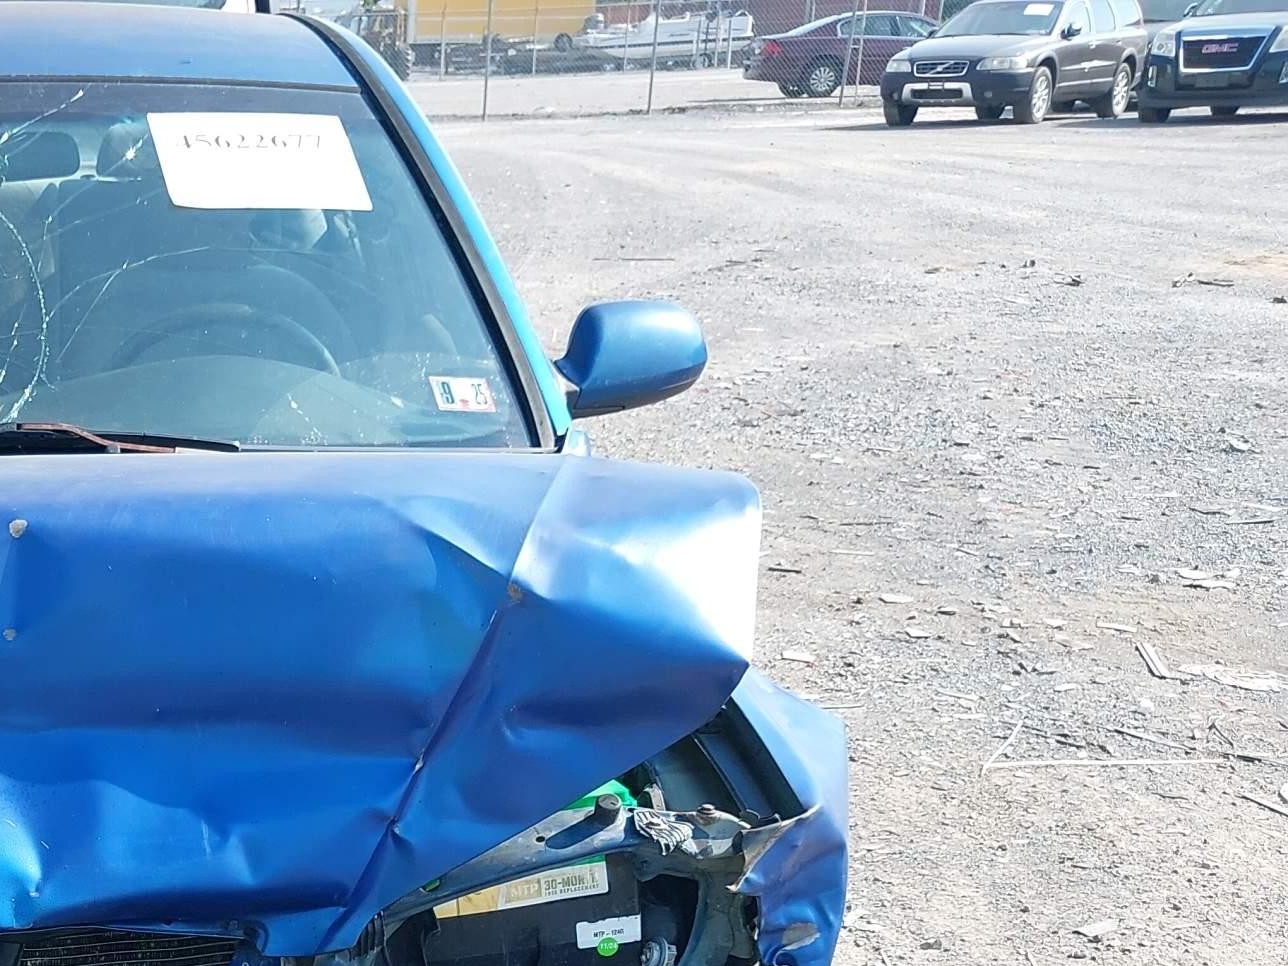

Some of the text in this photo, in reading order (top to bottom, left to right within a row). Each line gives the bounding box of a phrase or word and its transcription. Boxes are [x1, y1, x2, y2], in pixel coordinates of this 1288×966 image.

[1202, 43, 1239, 54] GMC
[176, 134, 321, 149] 45622677
[472, 383, 488, 404] 25
